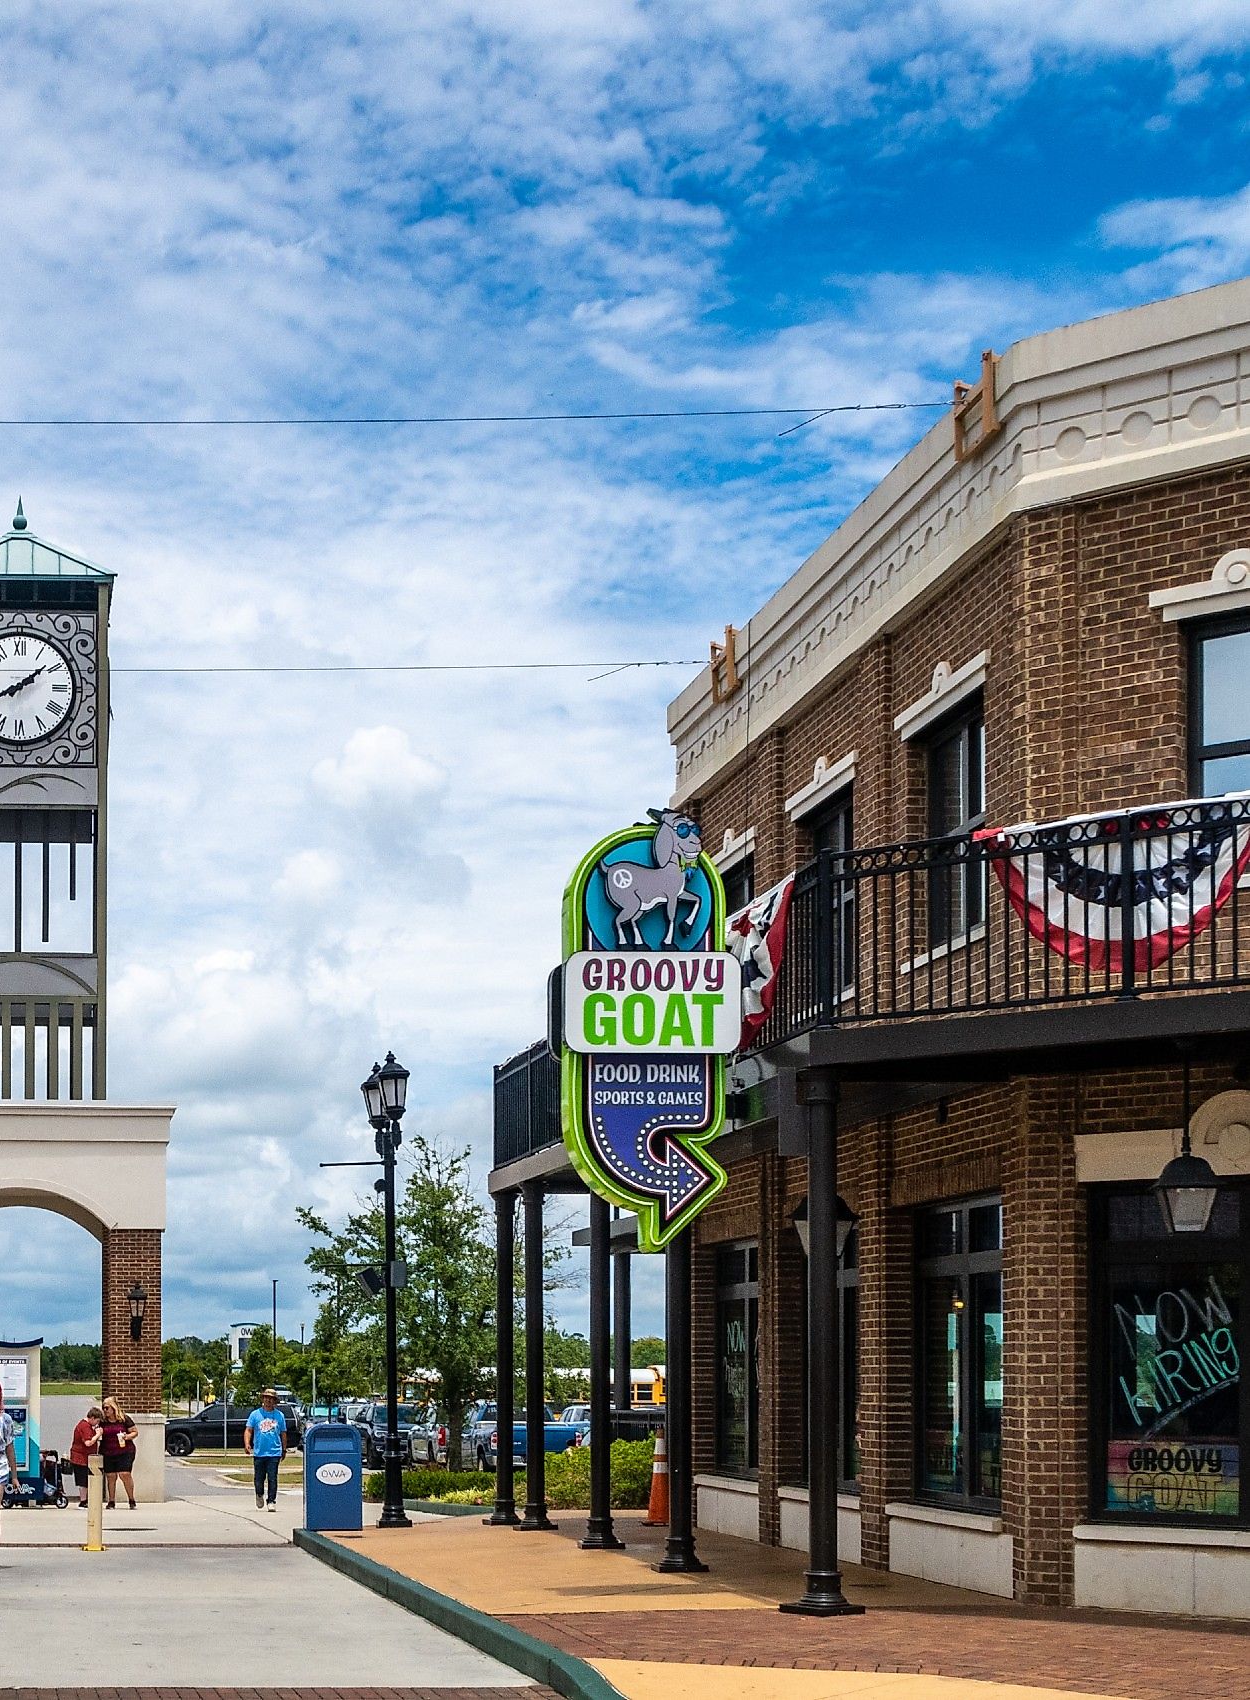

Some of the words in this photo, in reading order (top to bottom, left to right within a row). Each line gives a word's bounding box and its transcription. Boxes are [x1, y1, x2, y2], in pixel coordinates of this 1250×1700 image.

[582, 958, 725, 992] GROOVY
[582, 993, 725, 1048] GOAT
[594, 1063, 641, 1085] FOOD,
[646, 1063, 703, 1085] DRINK,
[594, 1091, 644, 1105] SPORTS
[646, 1091, 655, 1105] &
[658, 1091, 703, 1105] GAMES
[1114, 1275, 1233, 1360] NOW
[321, 1469, 346, 1478] OWA
[1127, 1447, 1223, 1473] GROOVY
[1126, 1471, 1223, 1513] GOAT
